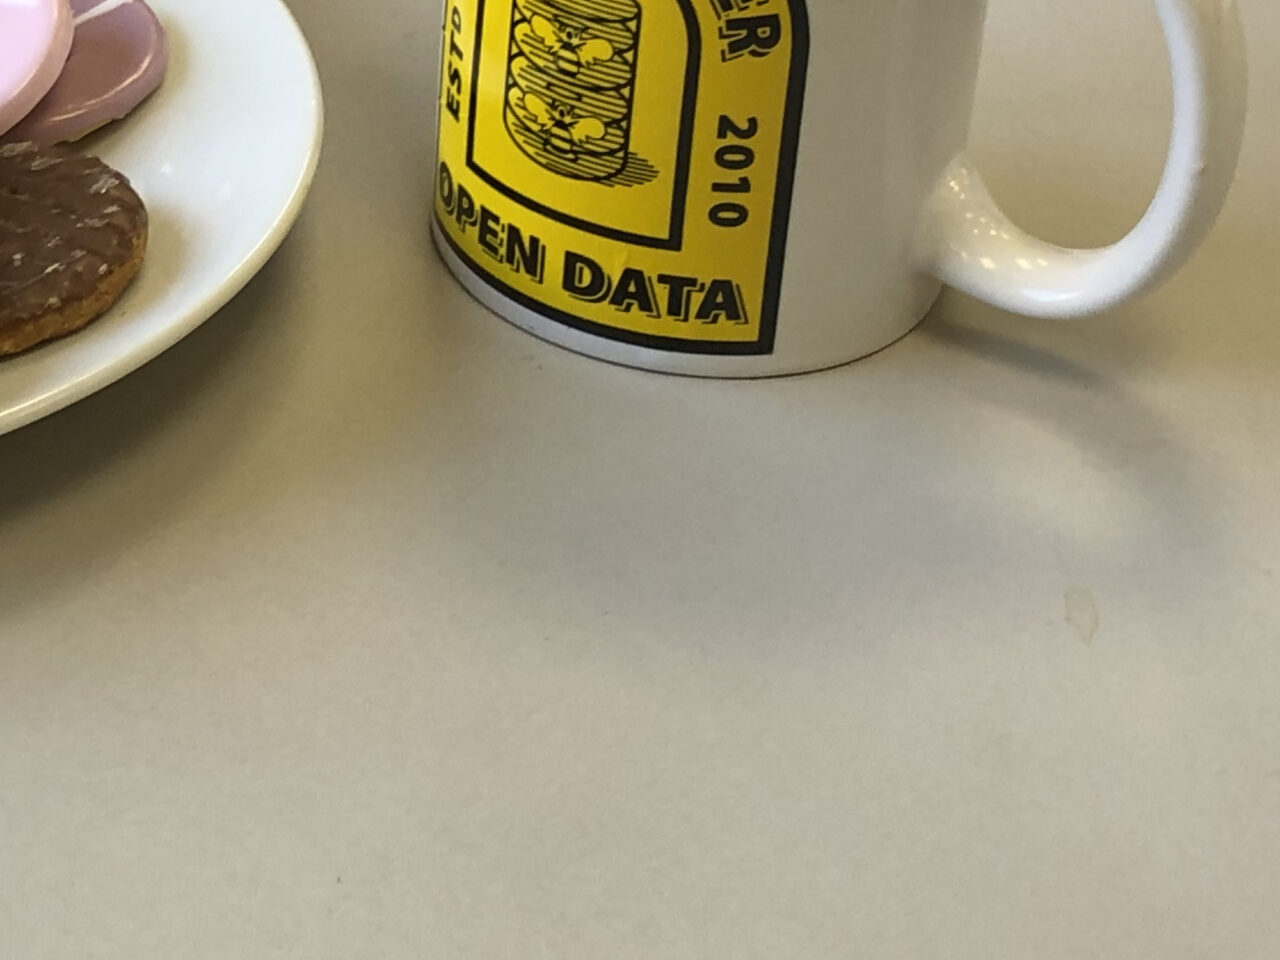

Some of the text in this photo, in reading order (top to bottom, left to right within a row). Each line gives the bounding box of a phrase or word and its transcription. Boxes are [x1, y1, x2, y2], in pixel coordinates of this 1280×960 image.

[446, 5, 464, 124] ESTD
[708, 114, 758, 228] 2010
[439, 161, 749, 325] OPEN DATA
